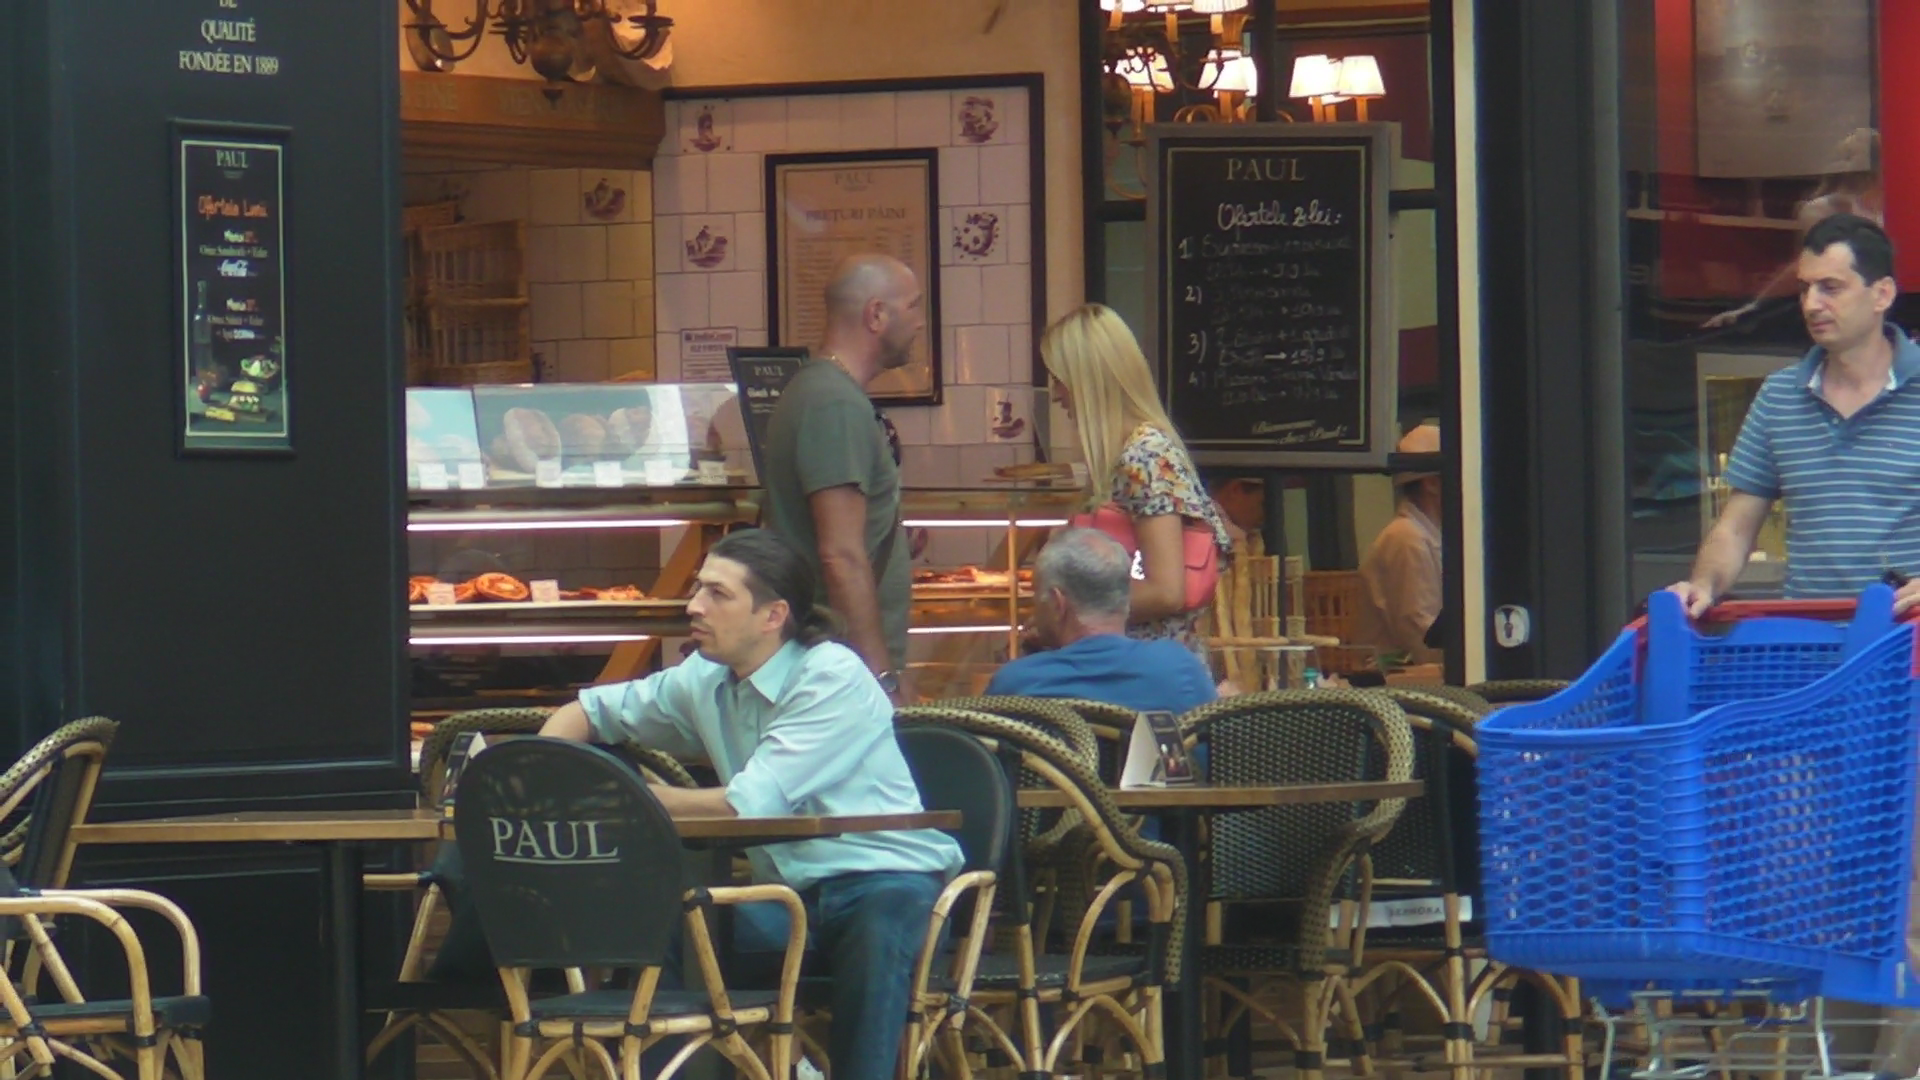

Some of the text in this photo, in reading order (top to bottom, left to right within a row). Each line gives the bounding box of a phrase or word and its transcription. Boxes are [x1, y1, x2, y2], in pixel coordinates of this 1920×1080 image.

[201, 18, 257, 43] QUALITÉ
[179, 47, 232, 73] FONDÉE
[233, 54, 252, 73] EN
[215, 149, 249, 168] PAUL
[1226, 157, 1305, 181] PAUL
[753, 365, 785, 377] PAUL
[488, 816, 619, 860] PAUL
